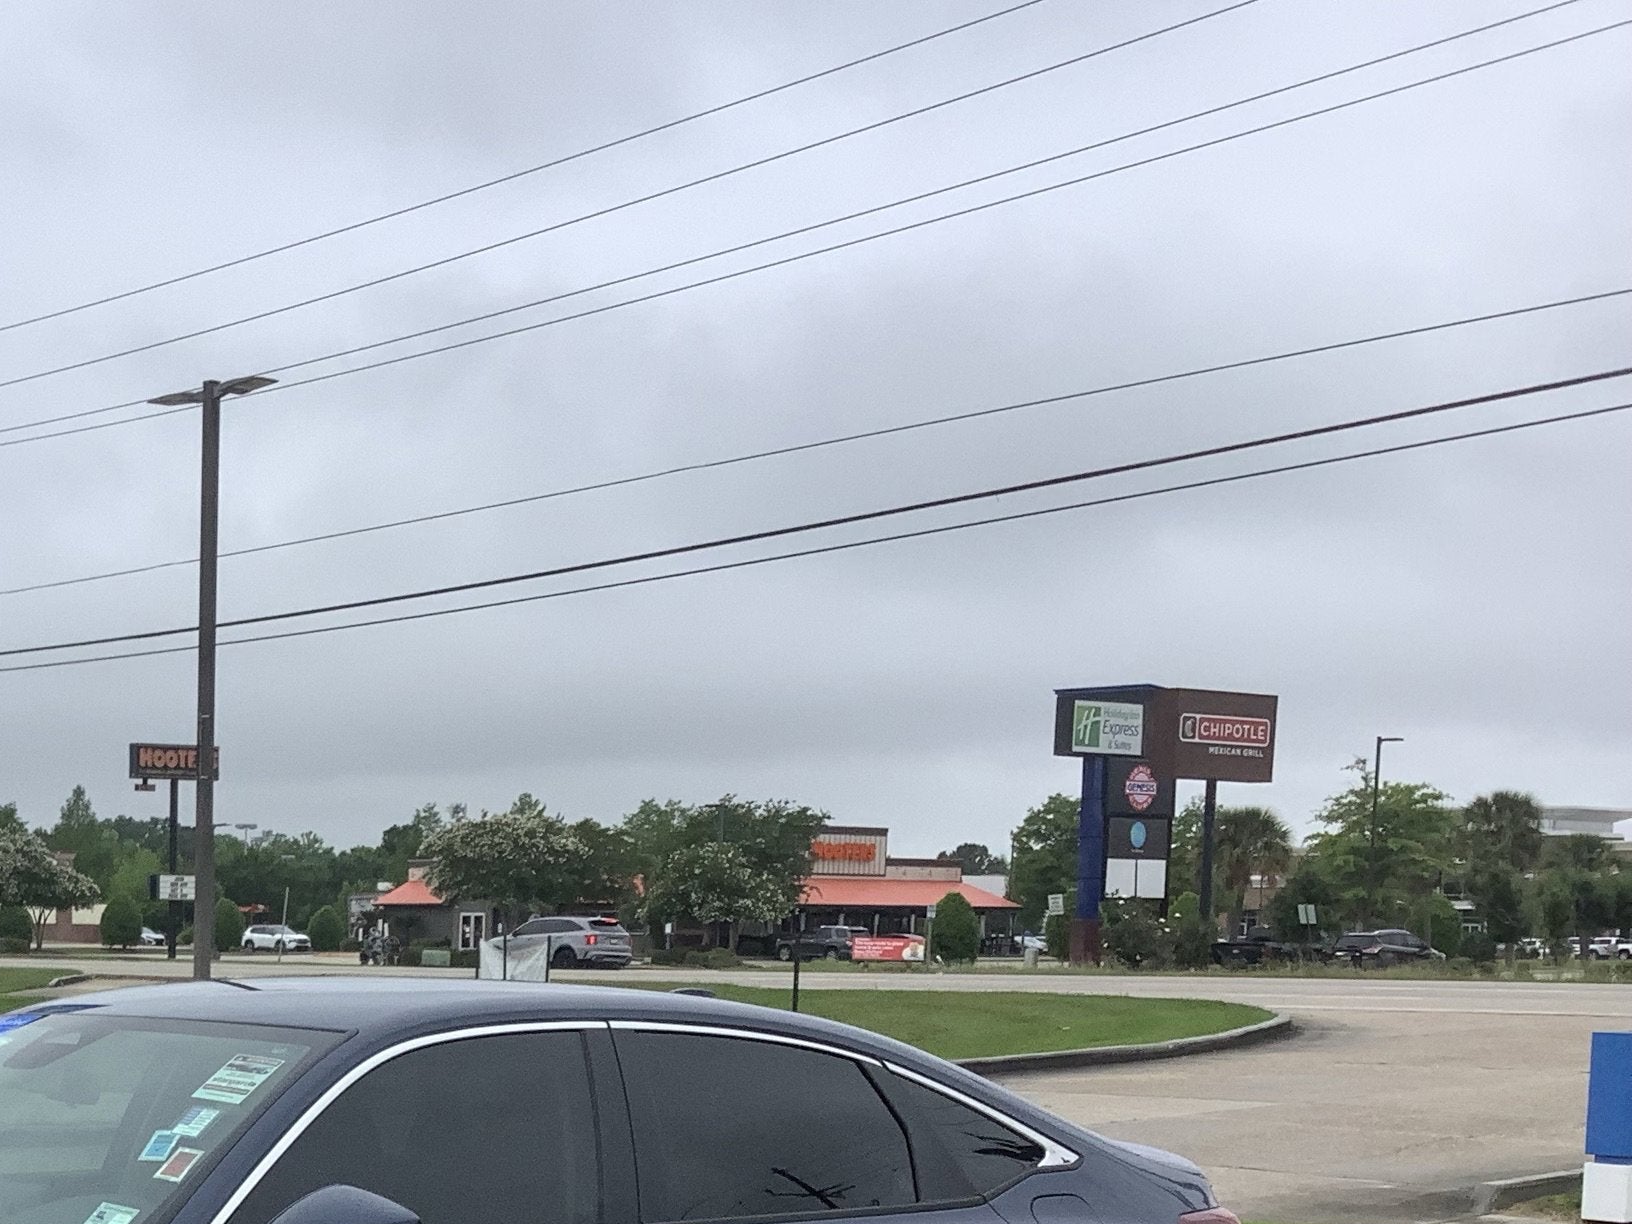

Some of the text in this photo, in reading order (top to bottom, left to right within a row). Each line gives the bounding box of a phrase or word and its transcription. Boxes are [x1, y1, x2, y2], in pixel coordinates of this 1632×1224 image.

[1102, 719, 1139, 739] Express
[1200, 721, 1266, 740] CHIPOTLE
[139, 747, 218, 770] HOOTE
[1208, 746, 1264, 758] MEXICAN GRILL
